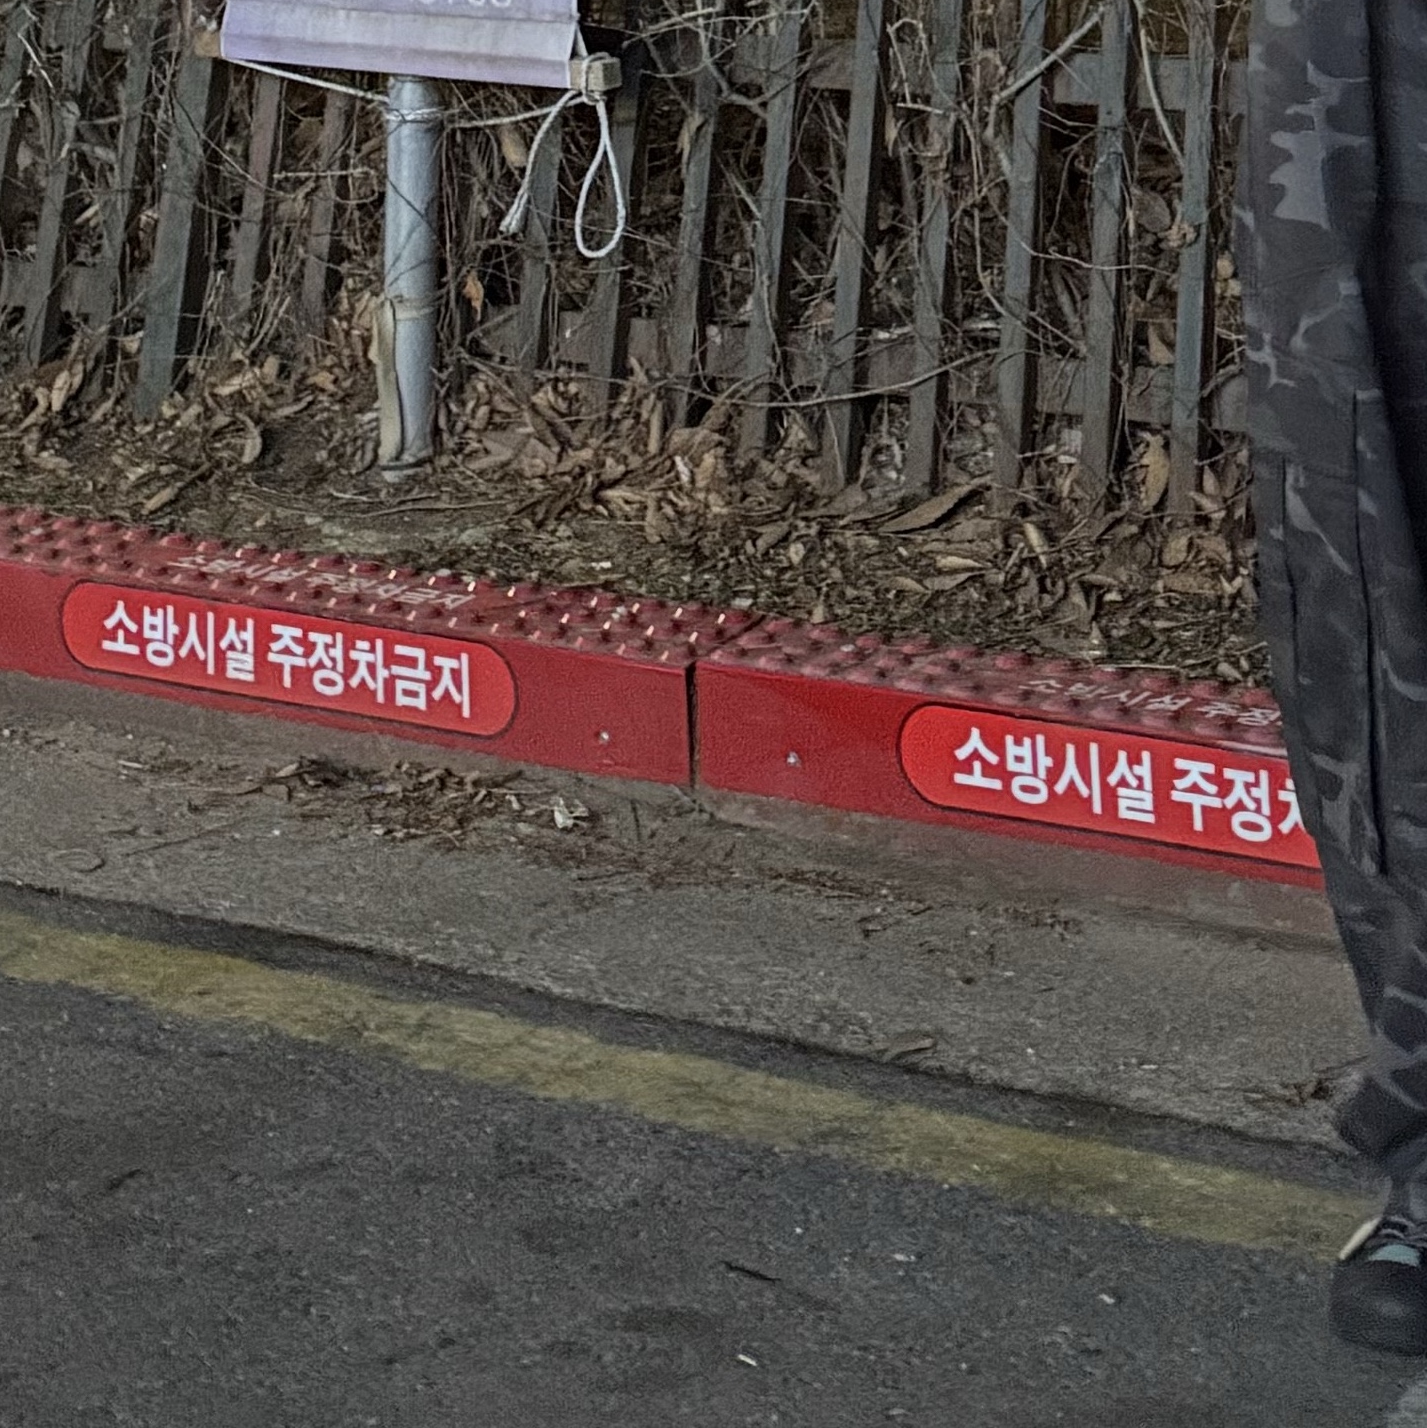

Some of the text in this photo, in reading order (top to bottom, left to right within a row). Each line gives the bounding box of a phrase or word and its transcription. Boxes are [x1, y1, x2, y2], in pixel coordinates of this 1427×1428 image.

[101, 600, 472, 719] 소방시설 주정차금지
[953, 726, 1157, 825] 소방시설
